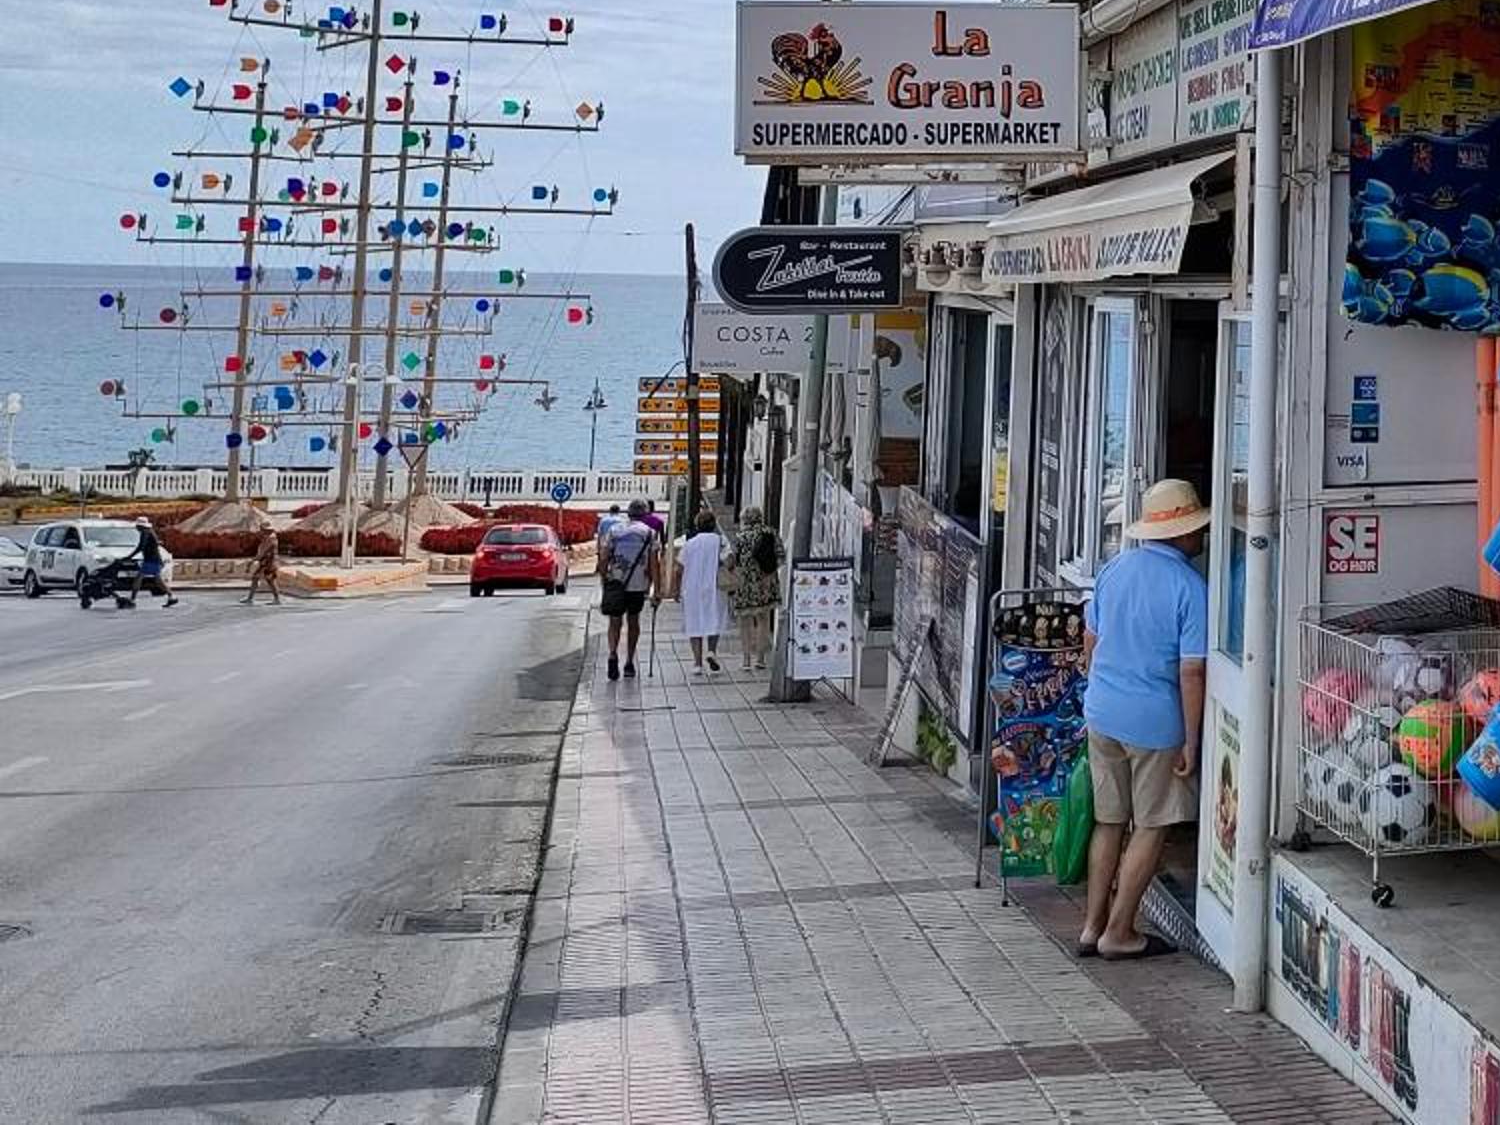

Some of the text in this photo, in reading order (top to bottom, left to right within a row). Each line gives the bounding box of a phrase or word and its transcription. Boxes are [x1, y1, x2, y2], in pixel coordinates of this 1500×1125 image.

[931, 10, 992, 57] La
[886, 62, 1045, 120] Granja
[752, 122, 907, 147] SUPERMERCADO
[923, 122, 1061, 146] SUPERMARKET
[717, 327, 791, 343] COSTA
[1336, 455, 1365, 468] VISA
[1328, 515, 1378, 561] SE
[1328, 560, 1377, 573] OG HØR
